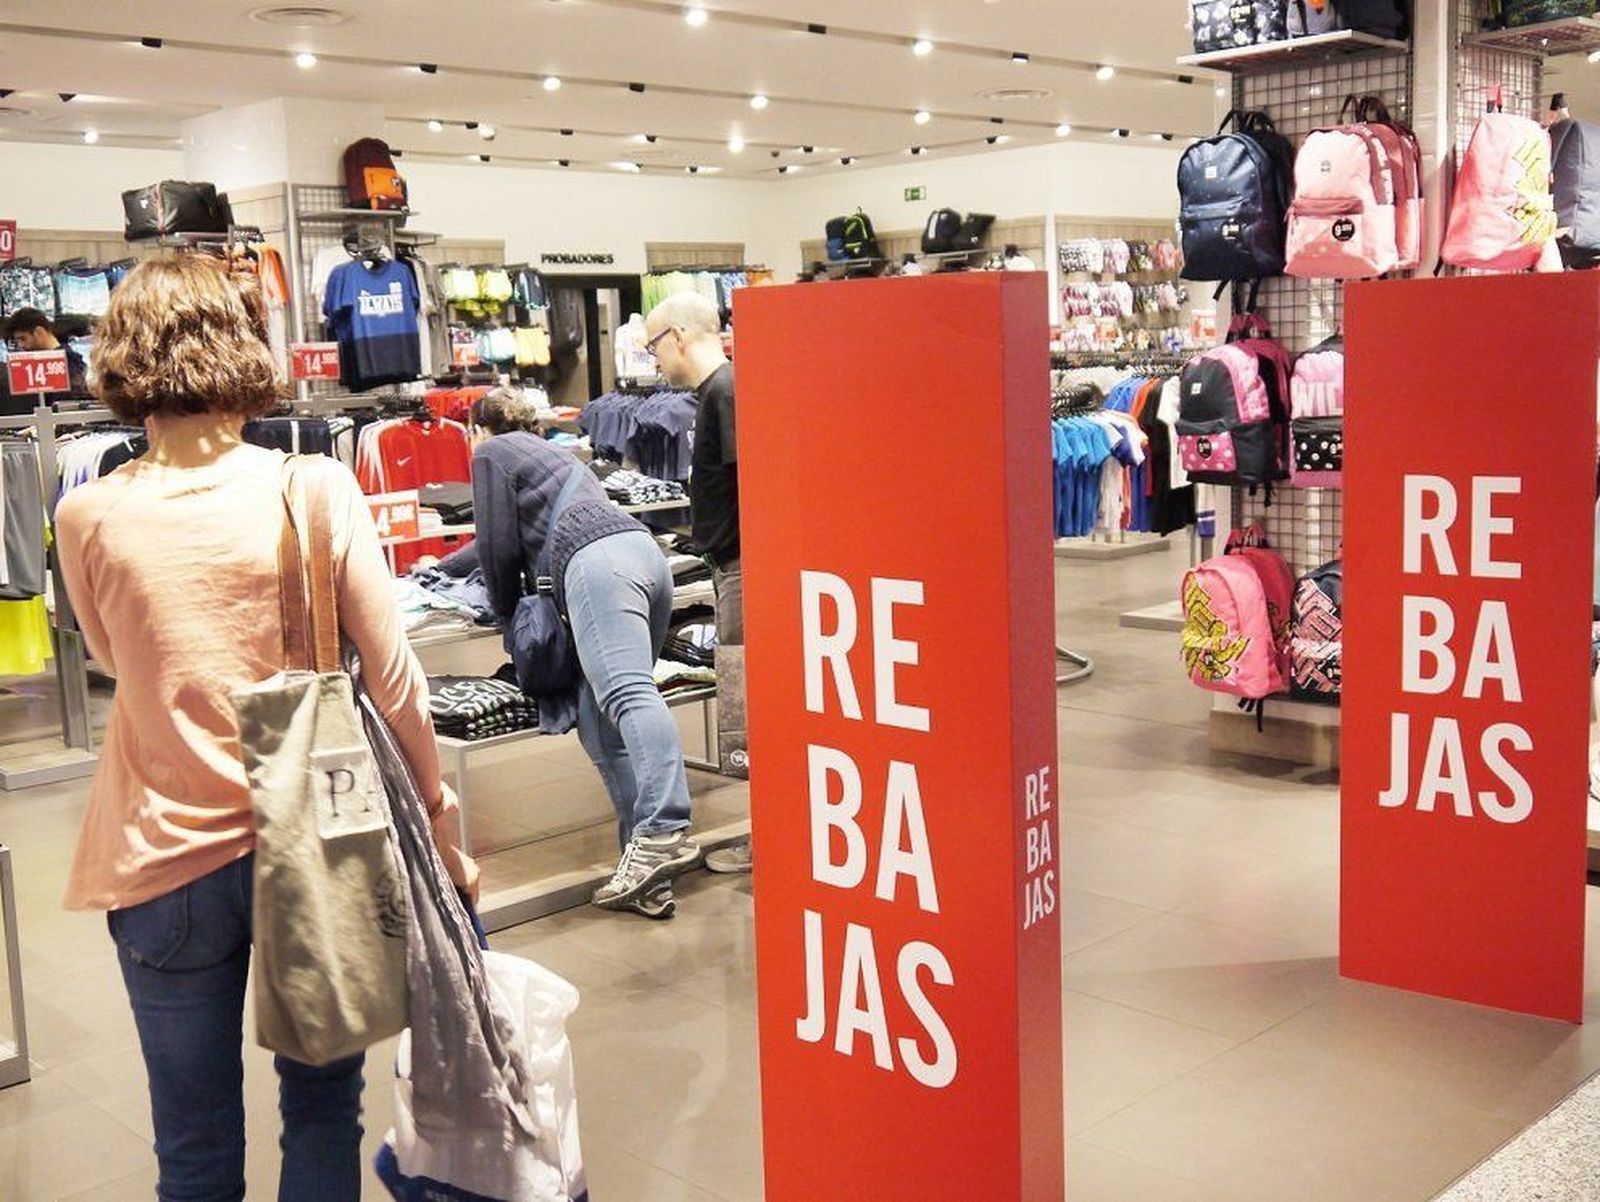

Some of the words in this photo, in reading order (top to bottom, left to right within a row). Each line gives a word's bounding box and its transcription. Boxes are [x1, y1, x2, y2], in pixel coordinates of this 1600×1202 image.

[541, 253, 614, 264] PROBADORES
[1403, 475, 1522, 578] RE
[800, 570, 930, 732] RE
[1402, 595, 1522, 702] BA
[1025, 766, 1051, 820] RE
[1379, 712, 1533, 823] JAS
[807, 744, 940, 914] BA
[1027, 820, 1052, 874] BA
[1024, 870, 1056, 930] JAS
[796, 909, 958, 1088] JAS
